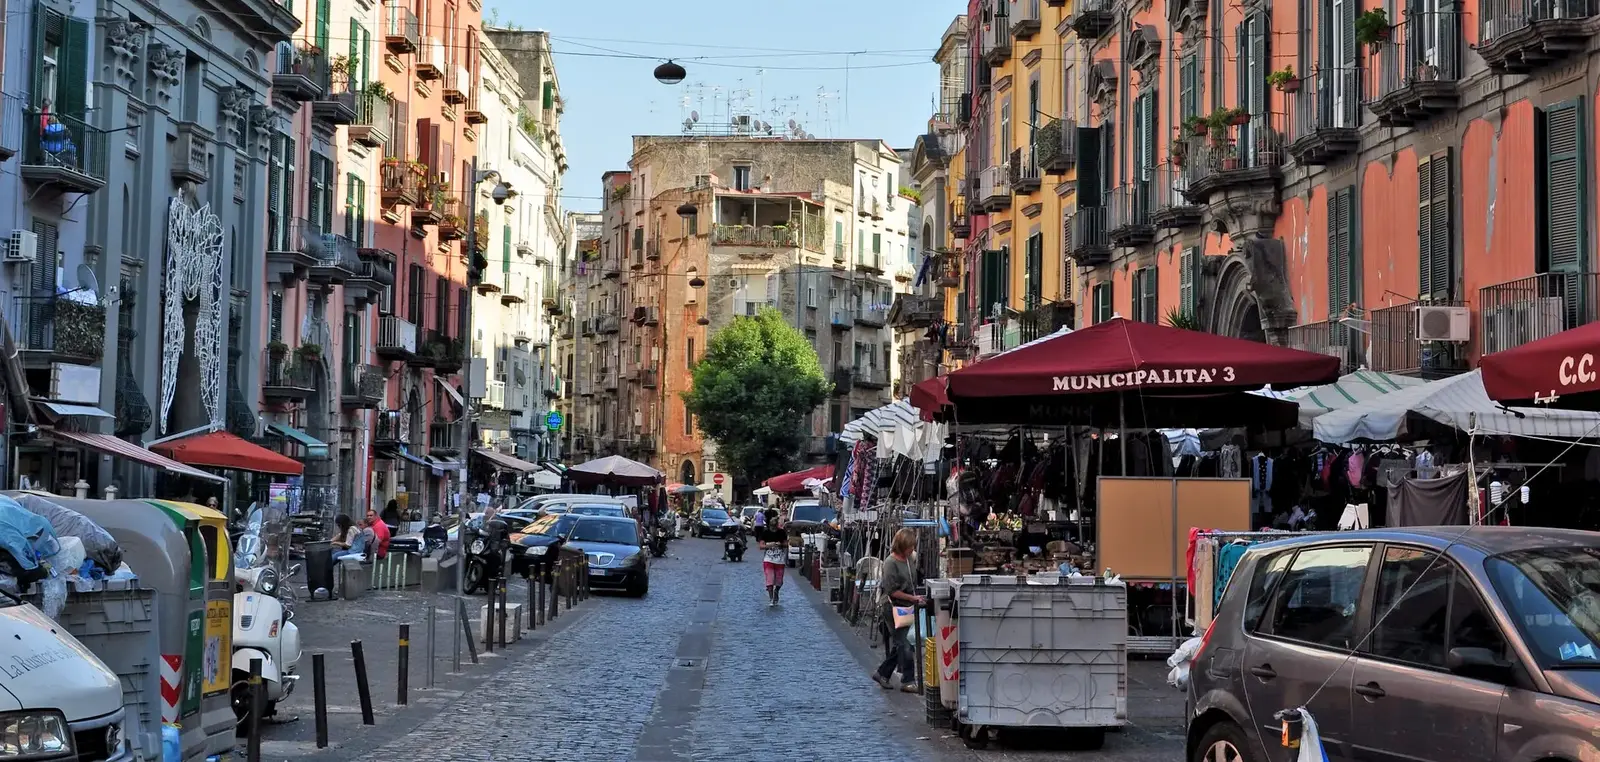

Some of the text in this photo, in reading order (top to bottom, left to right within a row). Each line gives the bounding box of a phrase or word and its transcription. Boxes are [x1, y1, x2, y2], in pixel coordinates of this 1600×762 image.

[1052, 366, 1236, 391] MUNICIPALITA' 3
[1558, 352, 1596, 386] C.C.
[0, 664, 24, 680] La
